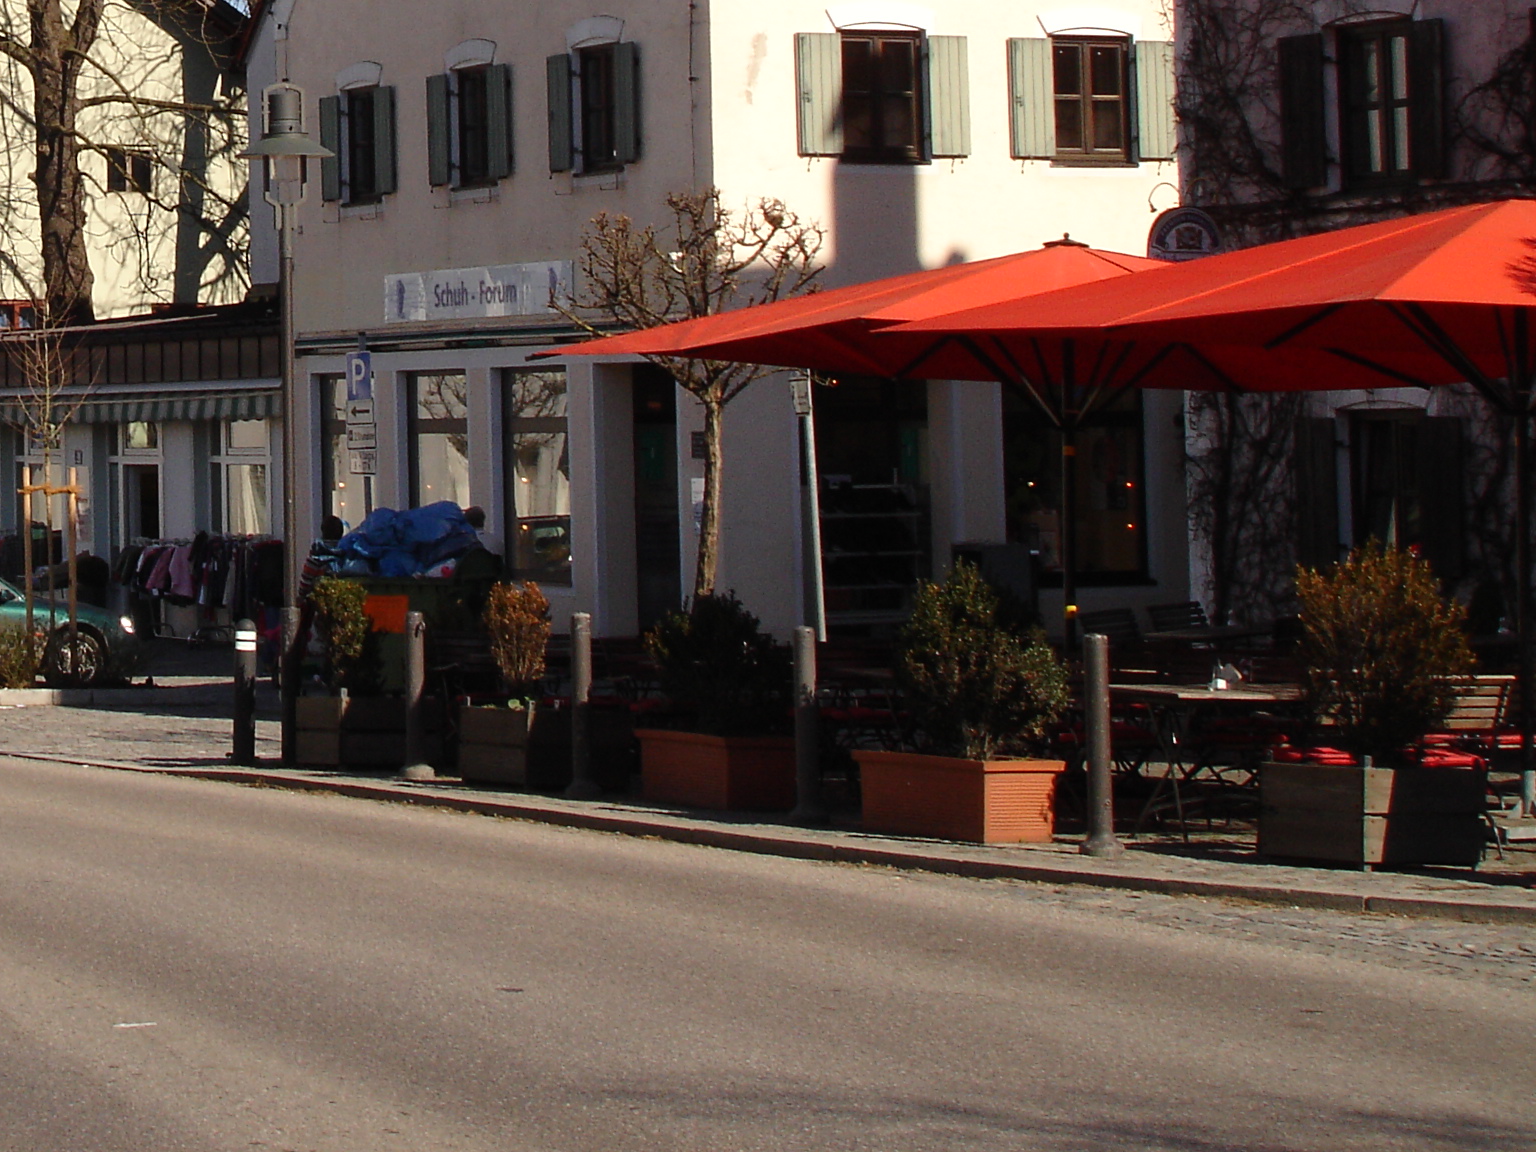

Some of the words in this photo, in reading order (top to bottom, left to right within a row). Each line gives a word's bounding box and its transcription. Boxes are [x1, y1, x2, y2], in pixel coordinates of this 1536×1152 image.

[433, 280, 469, 308] Schuh
[478, 279, 518, 305] Forum
[350, 358, 366, 396] P
